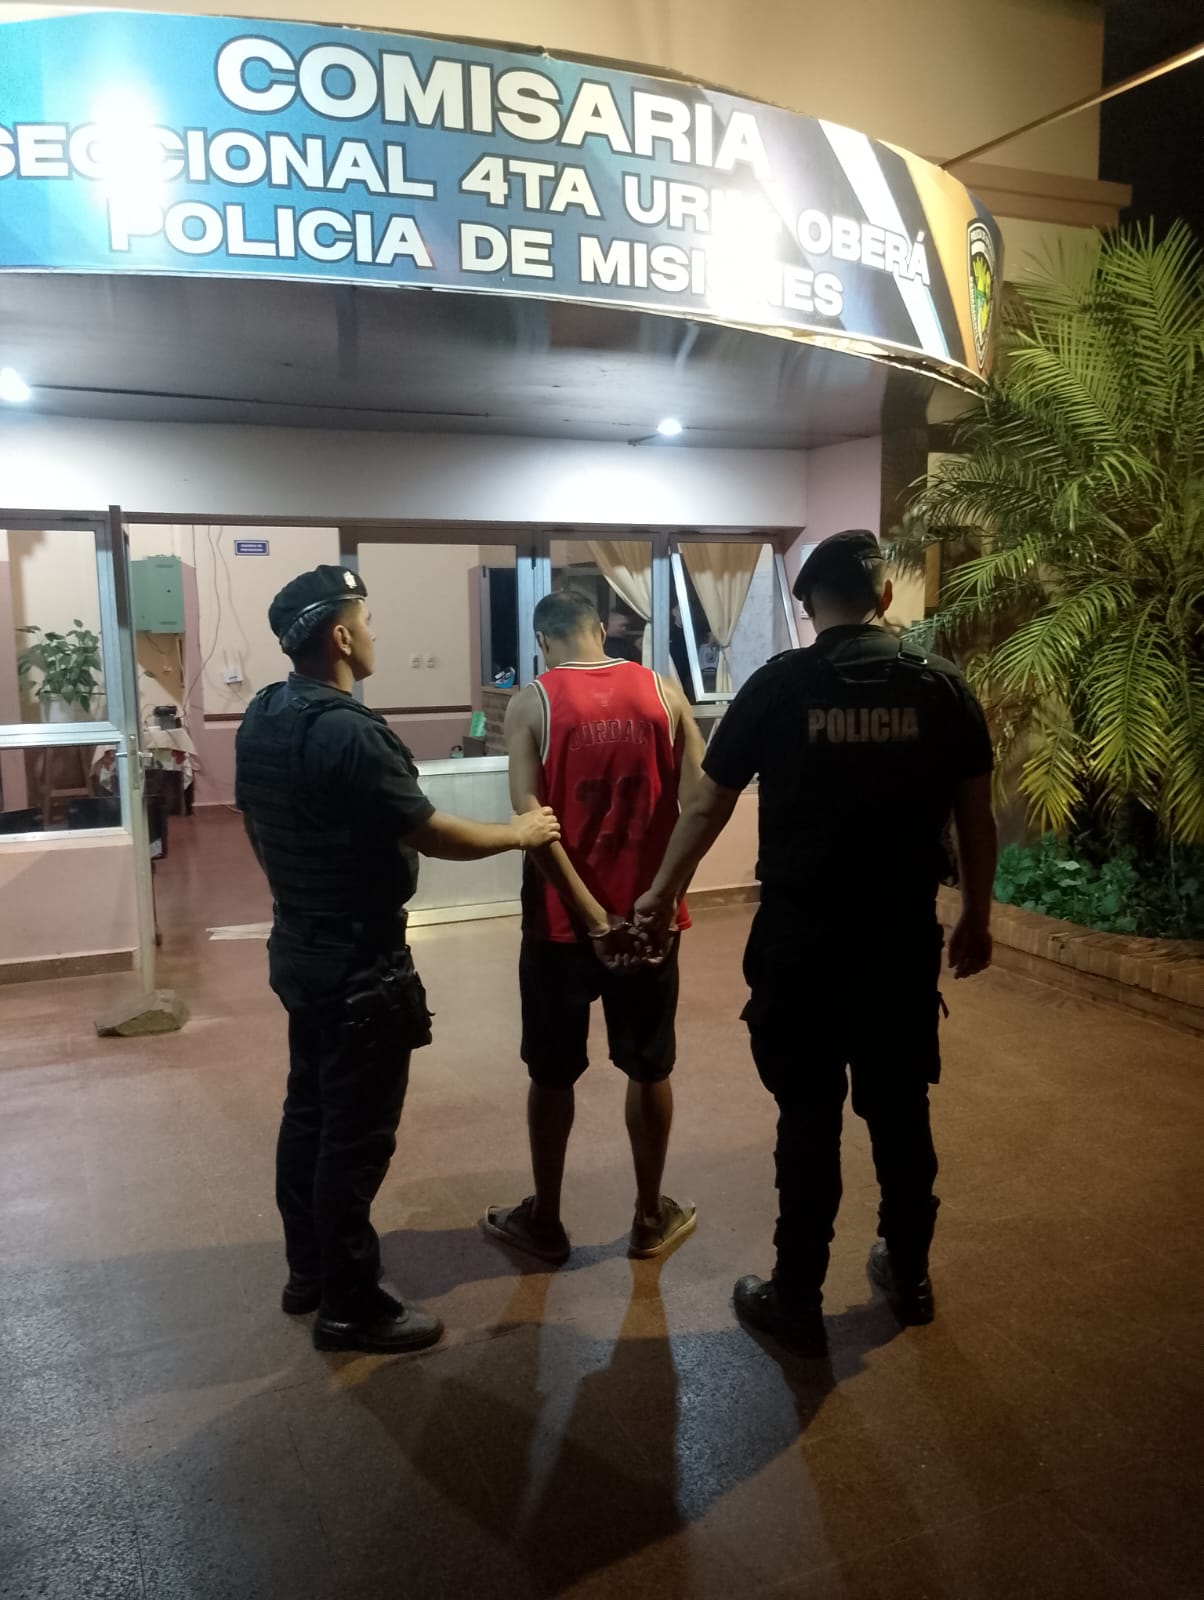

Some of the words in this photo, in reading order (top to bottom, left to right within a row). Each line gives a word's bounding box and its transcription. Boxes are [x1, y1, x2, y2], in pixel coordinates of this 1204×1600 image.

[216, 35, 772, 179] COMISARIA
[0, 124, 435, 199] ECCIONAL
[459, 155, 601, 219] 4TA
[797, 209, 931, 286] OBERÁ
[107, 196, 434, 270] POLICIA
[460, 223, 555, 279] DE
[579, 235, 845, 318] MISIES
[807, 706, 920, 743] POLICIA
